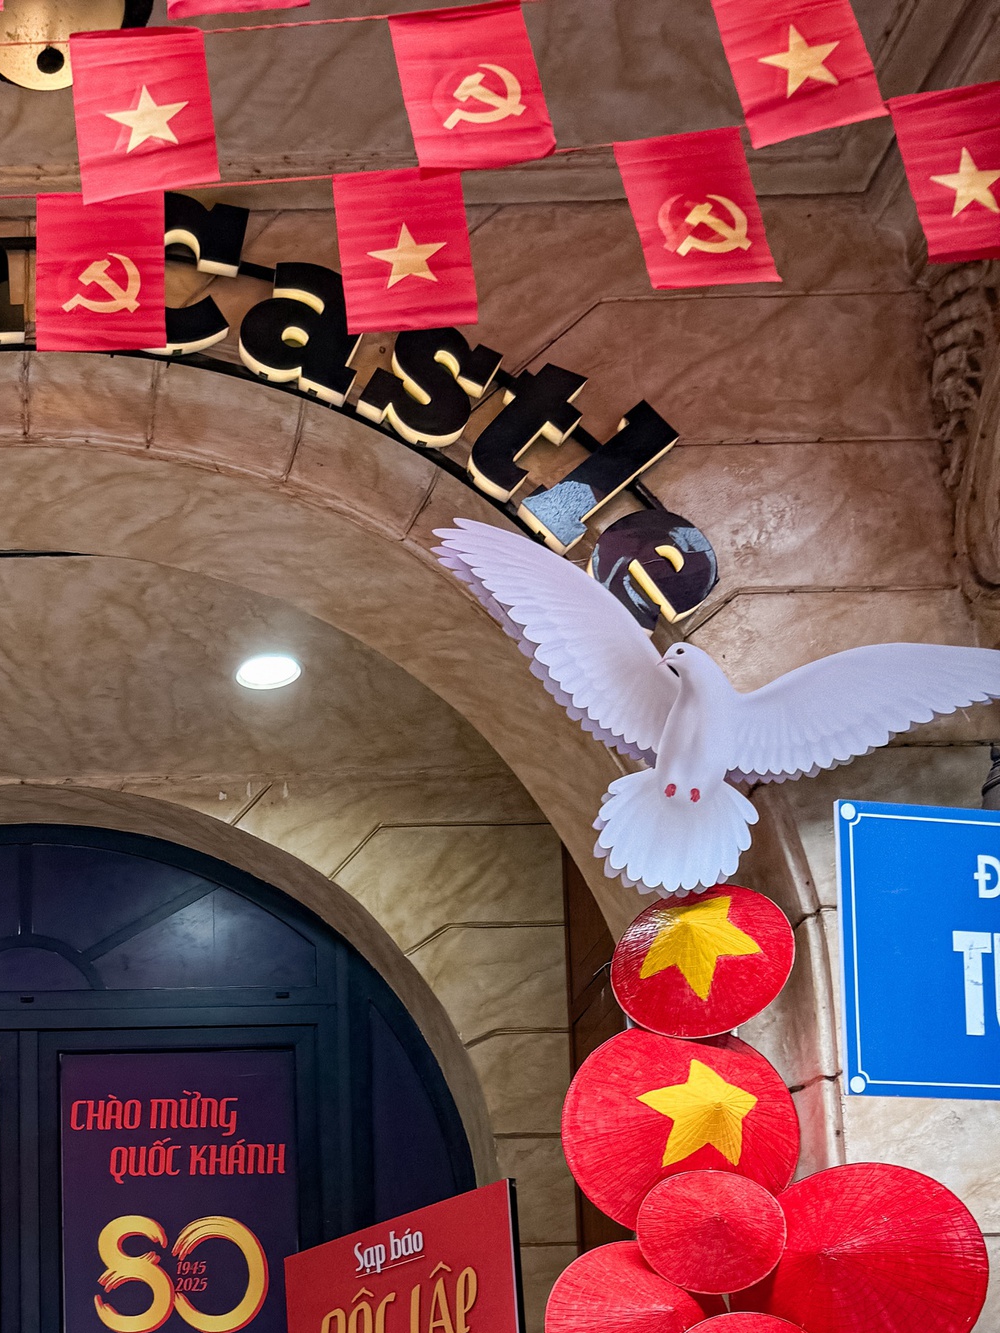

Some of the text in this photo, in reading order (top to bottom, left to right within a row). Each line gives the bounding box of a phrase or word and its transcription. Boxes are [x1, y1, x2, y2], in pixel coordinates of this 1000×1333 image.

[70, 1094, 142, 1131] CHÀO
[109, 1138, 286, 1185] QUỐC KHÁNH
[176, 1261, 207, 1275] 1945
[354, 1228, 424, 1274] Sạp báo
[175, 1277, 208, 1292] 2025
